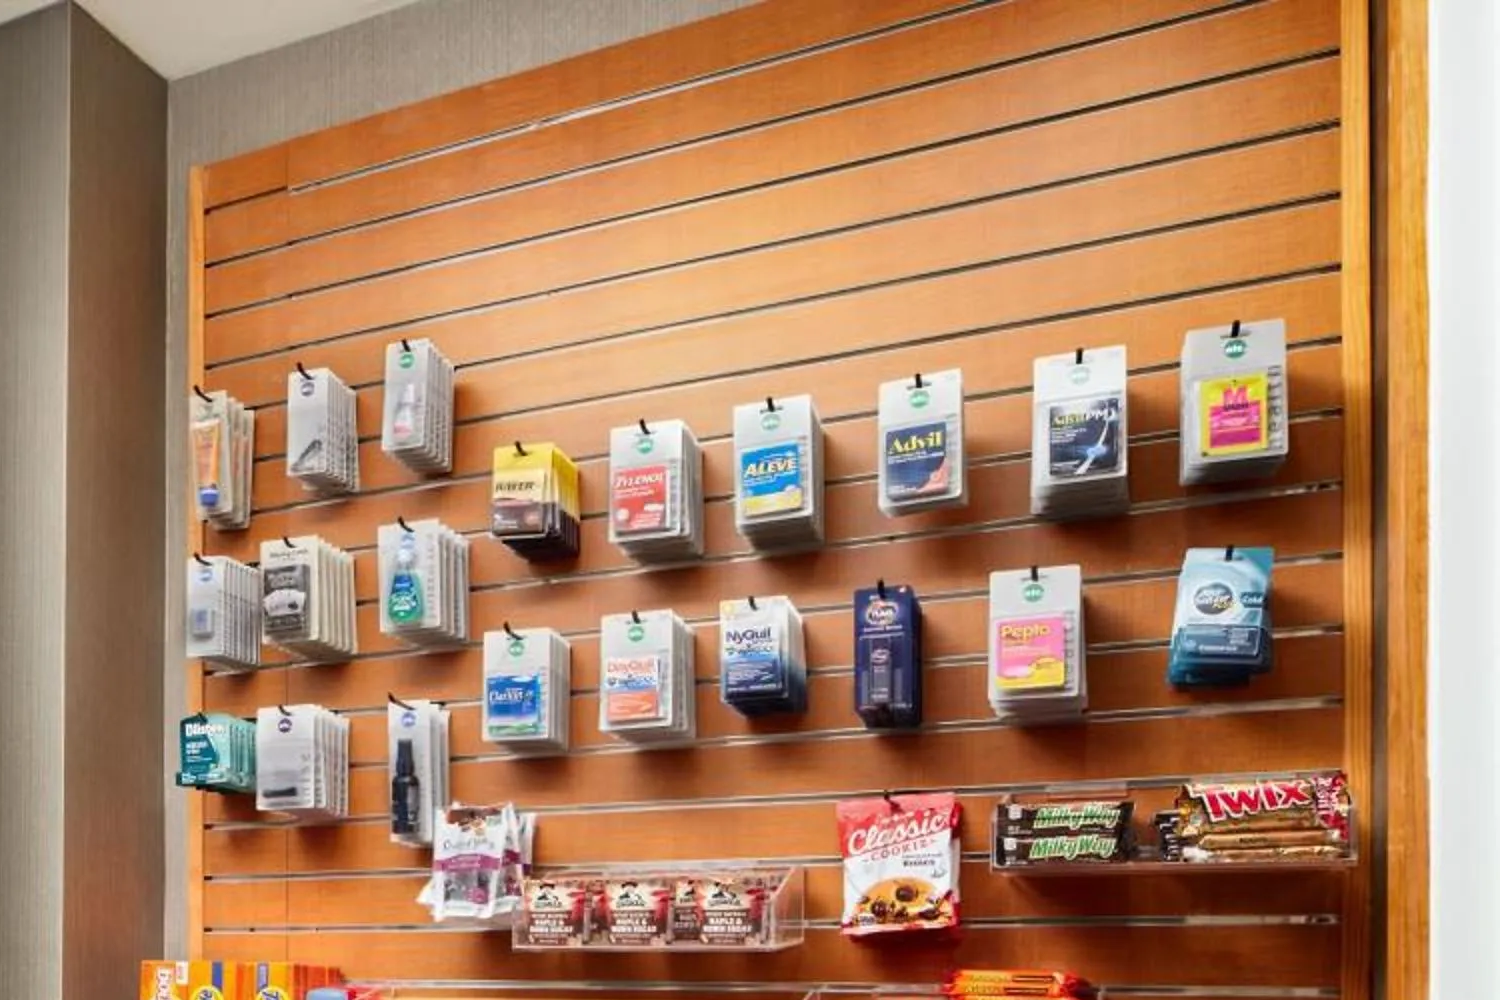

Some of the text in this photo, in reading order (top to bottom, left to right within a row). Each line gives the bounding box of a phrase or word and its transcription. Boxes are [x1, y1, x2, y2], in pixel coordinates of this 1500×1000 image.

[887, 430, 943, 455] Advil
[743, 457, 798, 478] ALEVE
[725, 627, 771, 644] NyQuil
[849, 812, 948, 856] Classic
